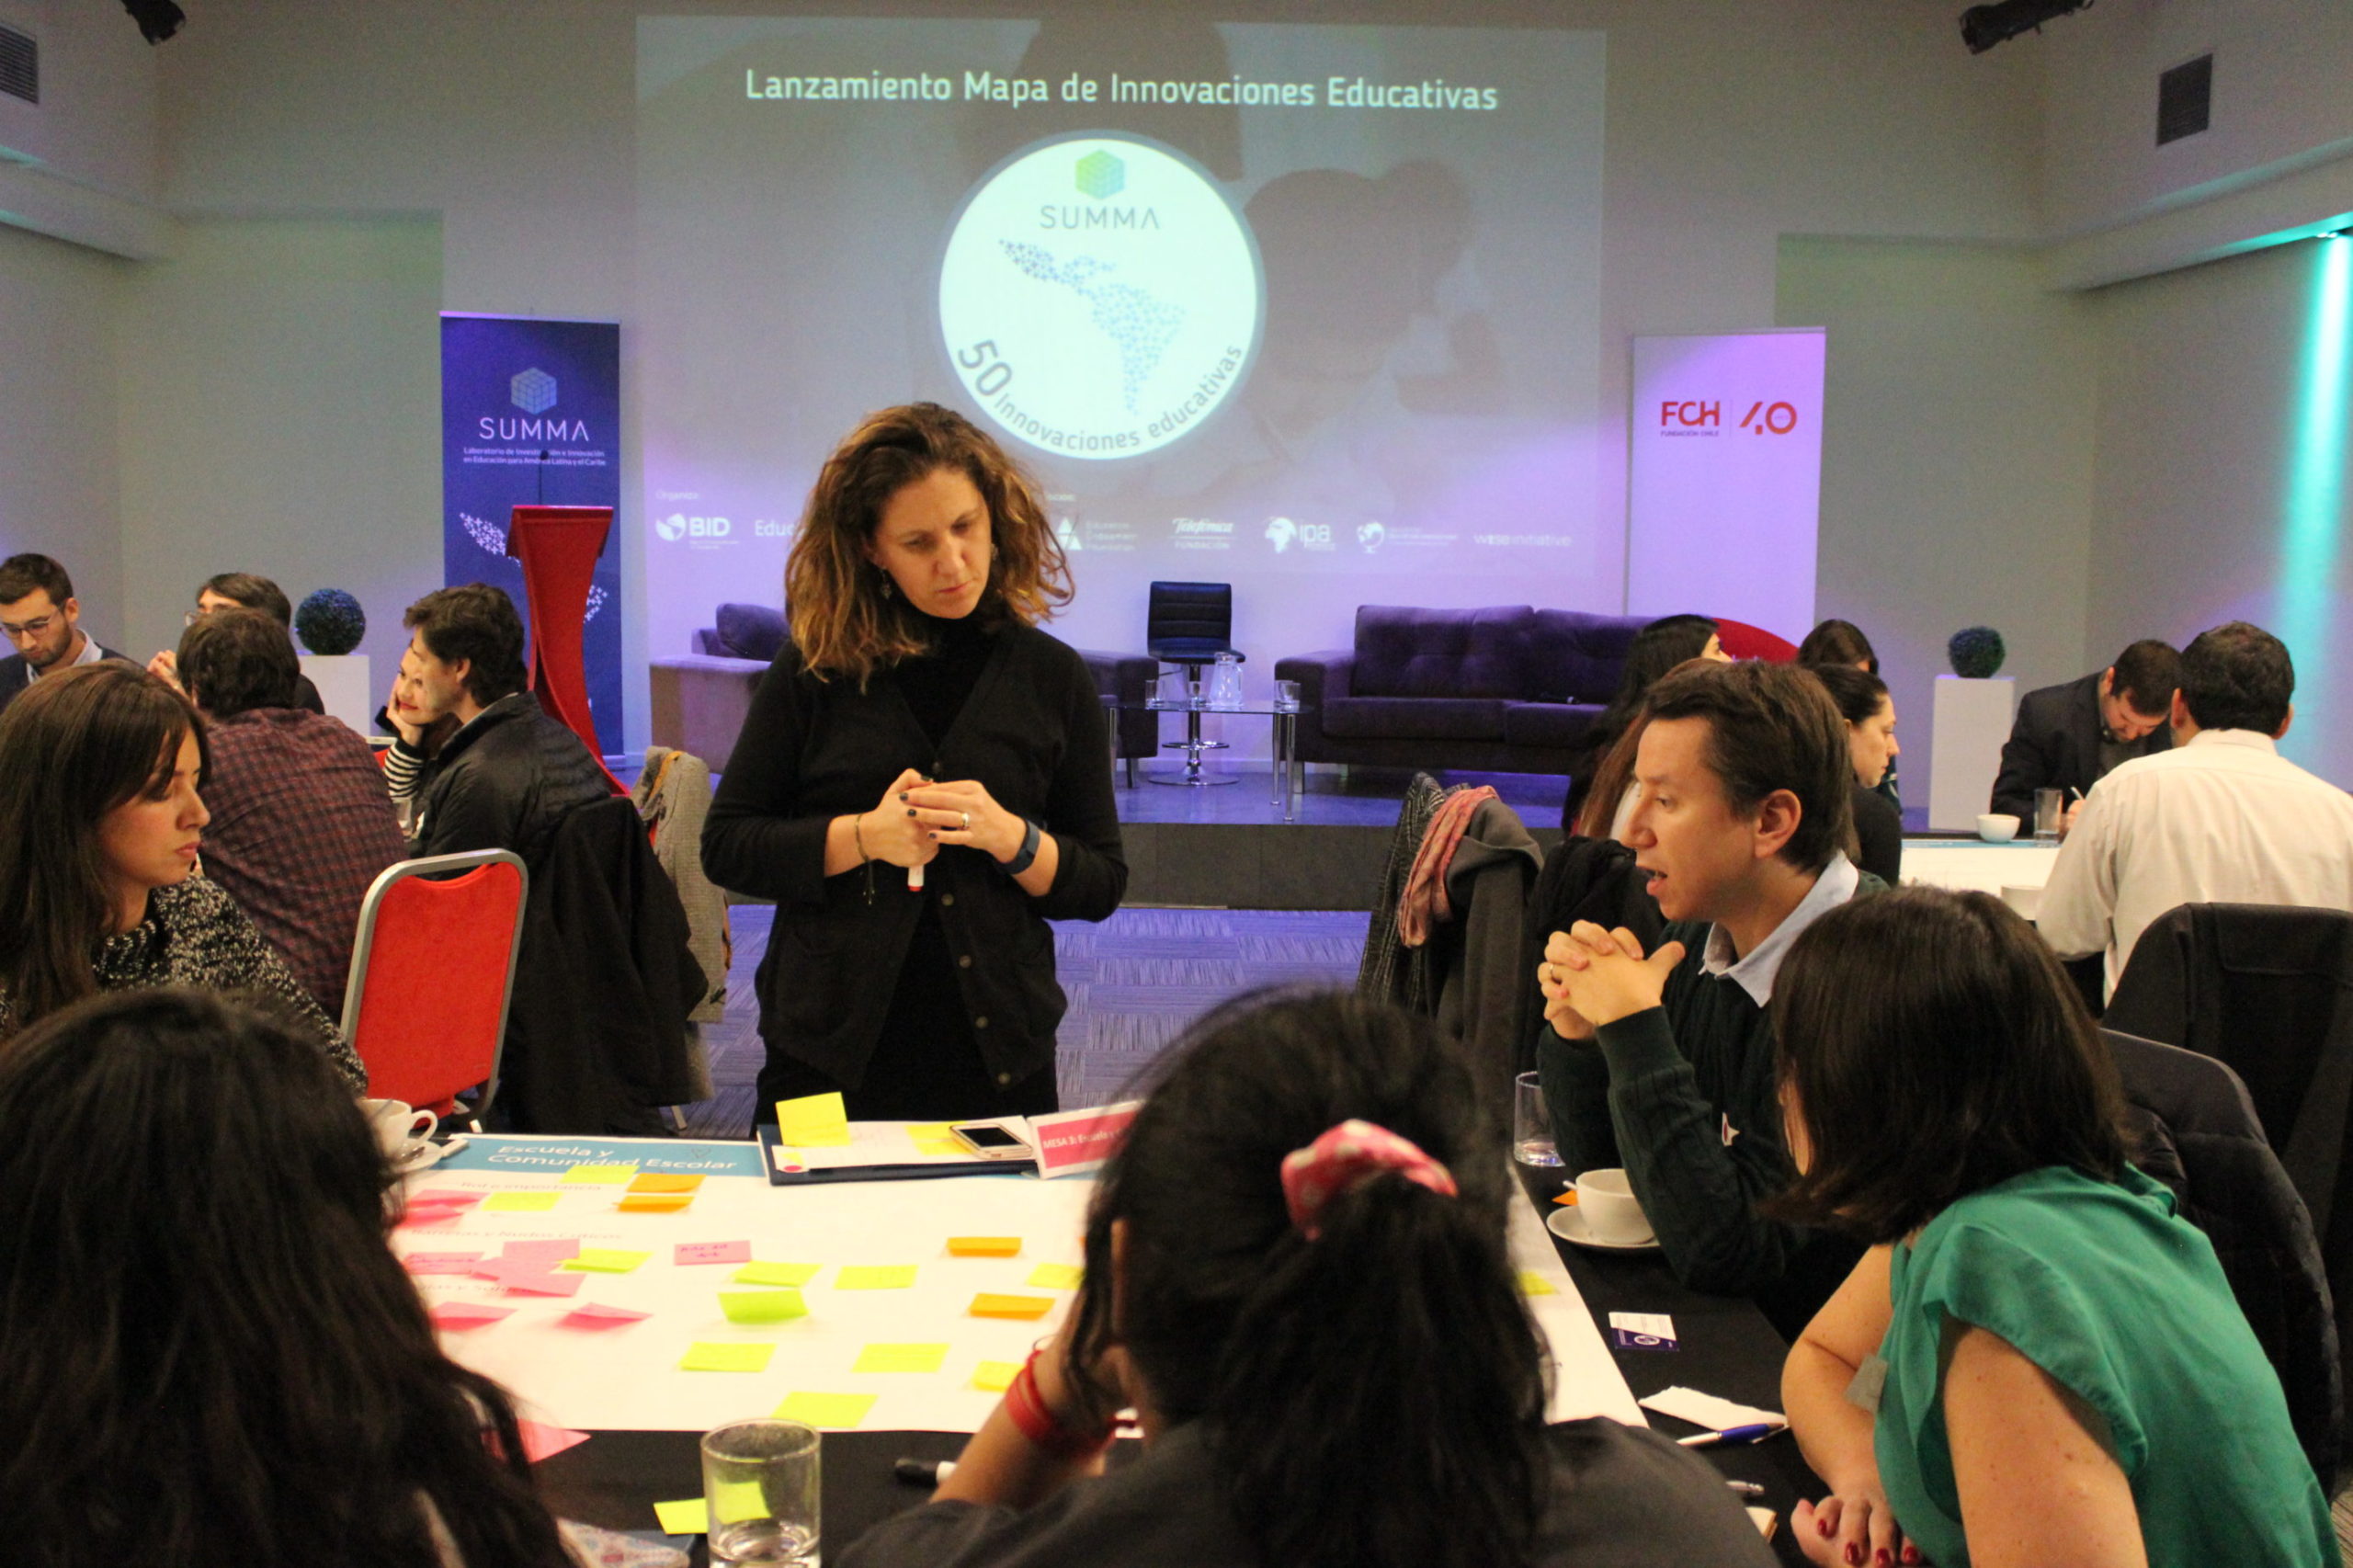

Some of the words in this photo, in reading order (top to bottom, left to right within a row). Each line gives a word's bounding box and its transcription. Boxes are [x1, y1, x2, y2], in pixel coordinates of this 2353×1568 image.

[746, 69, 952, 102] Lanzamiento
[964, 72, 1050, 109] Mapa
[1061, 73, 1098, 103] de
[1110, 74, 1315, 107] Innovaciones
[1327, 76, 1498, 110] Educativas
[1039, 204, 1160, 230] SUMMA
[958, 338, 1013, 397] 50
[1147, 344, 1243, 439] educativas
[1661, 401, 1721, 427] FCH
[478, 416, 589, 442] SUMMA
[689, 517, 732, 538] BID
[487, 1153, 641, 1167] Comunidad
[646, 1157, 738, 1169] Escolar
[498, 1145, 592, 1157] Escuela
[597, 1150, 616, 1159] y
